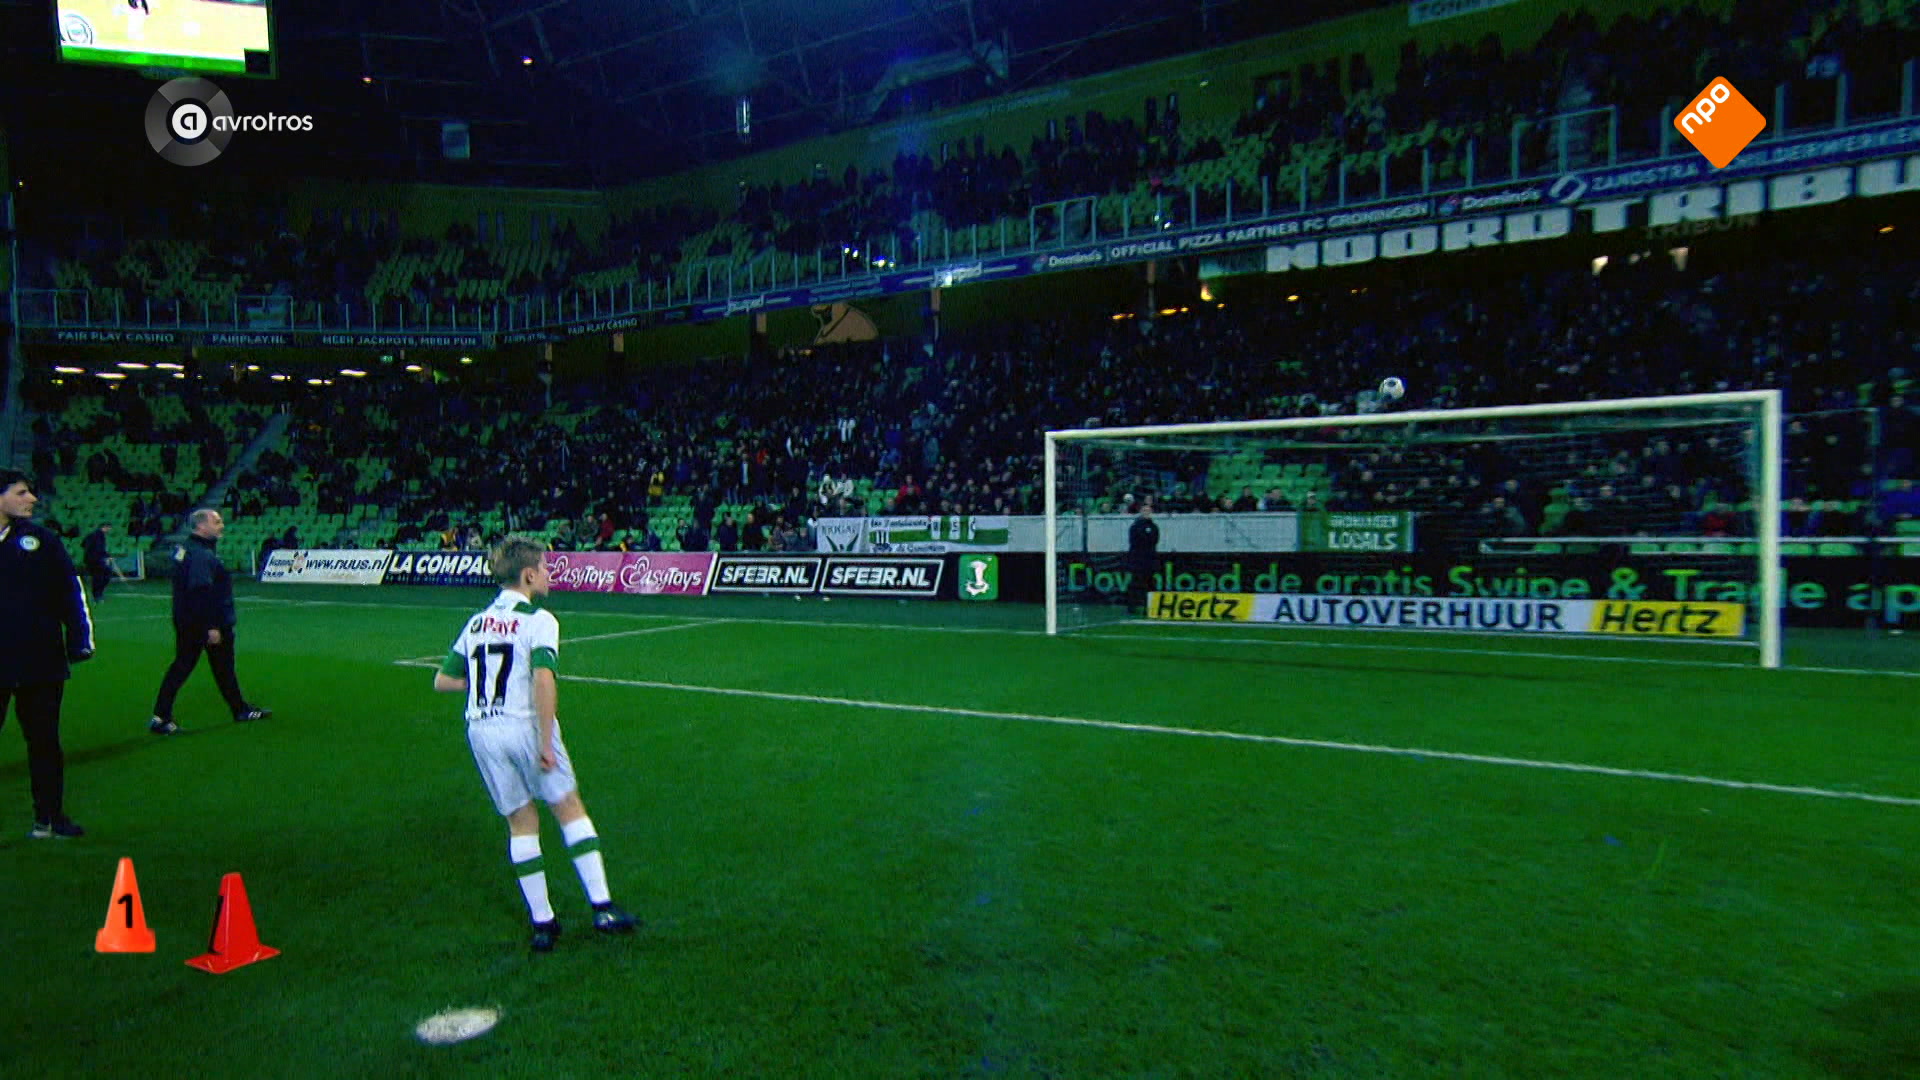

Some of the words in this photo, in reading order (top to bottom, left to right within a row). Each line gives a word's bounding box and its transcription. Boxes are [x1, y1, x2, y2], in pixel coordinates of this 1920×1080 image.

[1111, 239, 1176, 258] OFFICIAL
[1178, 231, 1223, 250] PIZZA
[1226, 221, 1299, 243] PARTNER
[1303, 217, 1325, 234] FC
[1327, 200, 1429, 230] GRONINGEN
[57, 331, 88, 342] FAIR
[90, 331, 121, 343] PLAY
[125, 332, 175, 344] CASINO
[389, 555, 409, 574] LA
[628, 556, 702, 591] EasyToys
[721, 565, 809, 586] SFEER.NL
[829, 566, 932, 589] SFEER.NL
[1254, 562, 1302, 593] de
[1315, 565, 1433, 597] gratis
[1447, 565, 1591, 598] Swipe
[1607, 566, 1647, 600] &
[1157, 593, 1240, 620] Hertz
[1275, 597, 1563, 631] AUTOVERHUUR
[1601, 602, 1720, 635] Hertz
[471, 643, 514, 707] 17
[117, 893, 133, 928] 1
